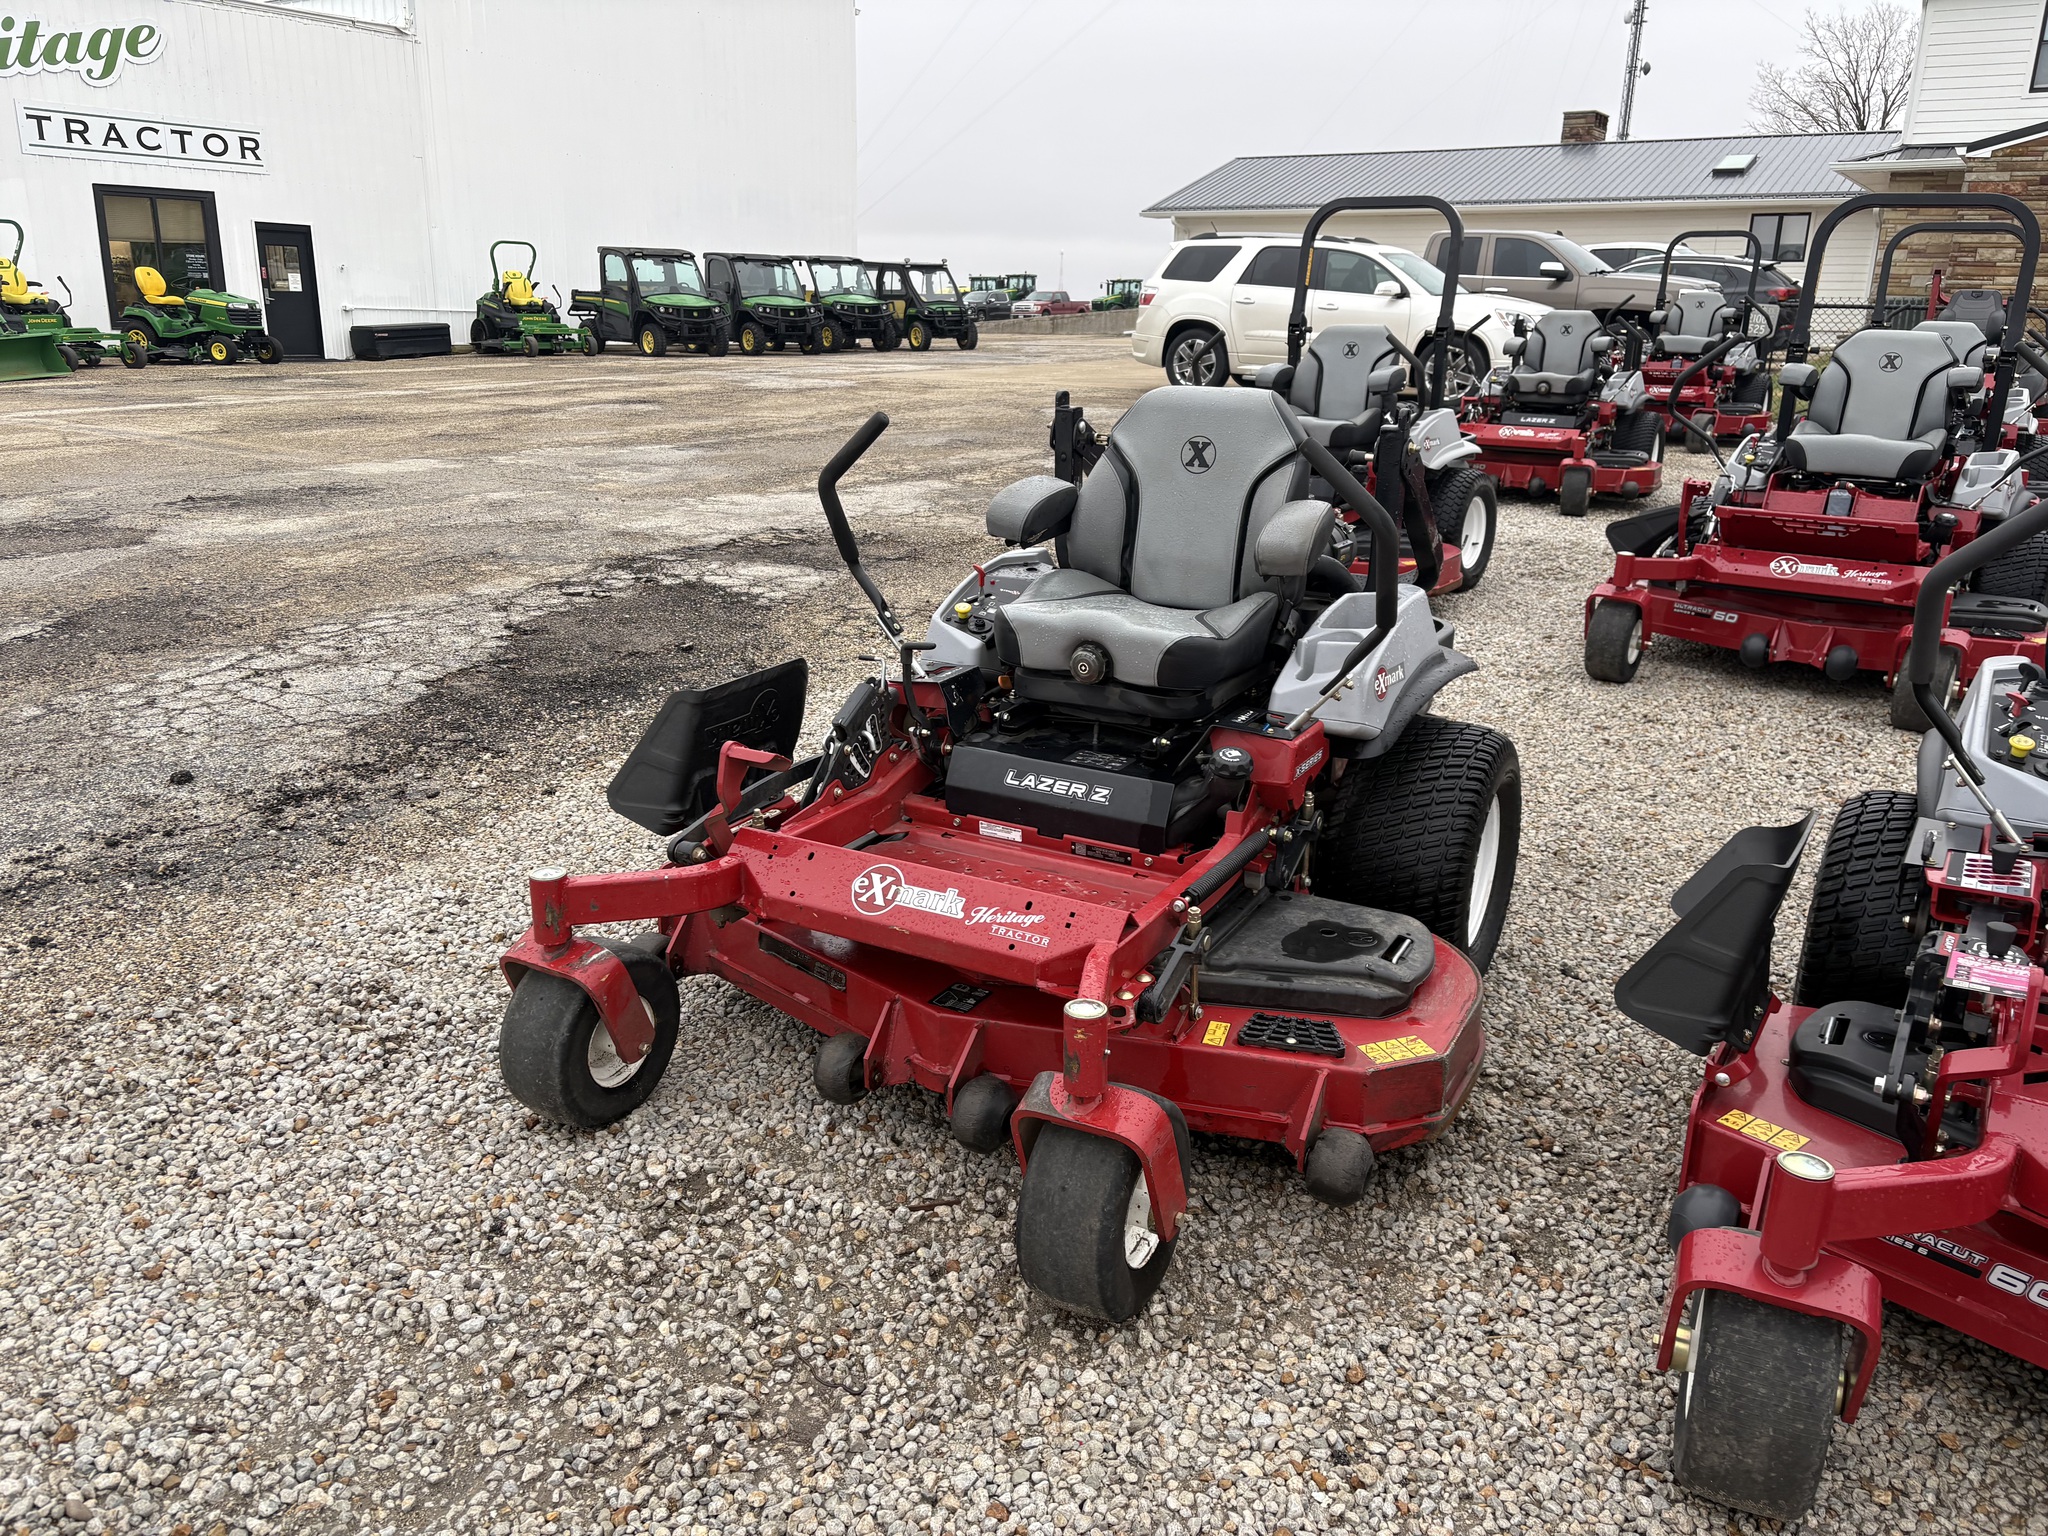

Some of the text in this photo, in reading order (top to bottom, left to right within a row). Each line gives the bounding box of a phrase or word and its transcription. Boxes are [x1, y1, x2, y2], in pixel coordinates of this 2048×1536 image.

[25, 113, 263, 161] TRACTOR
[1520, 416, 1549, 424] LAZER
[1841, 569, 1889, 579] Heritage
[1857, 576, 1893, 585] TRACTOR
[1673, 602, 1739, 623] ULTRACUT 60
[1004, 769, 1114, 805] LAZER Z
[964, 906, 1046, 927] Heritage
[991, 925, 1051, 946] TRACTOR
[1916, 1246, 1929, 1256] 6
